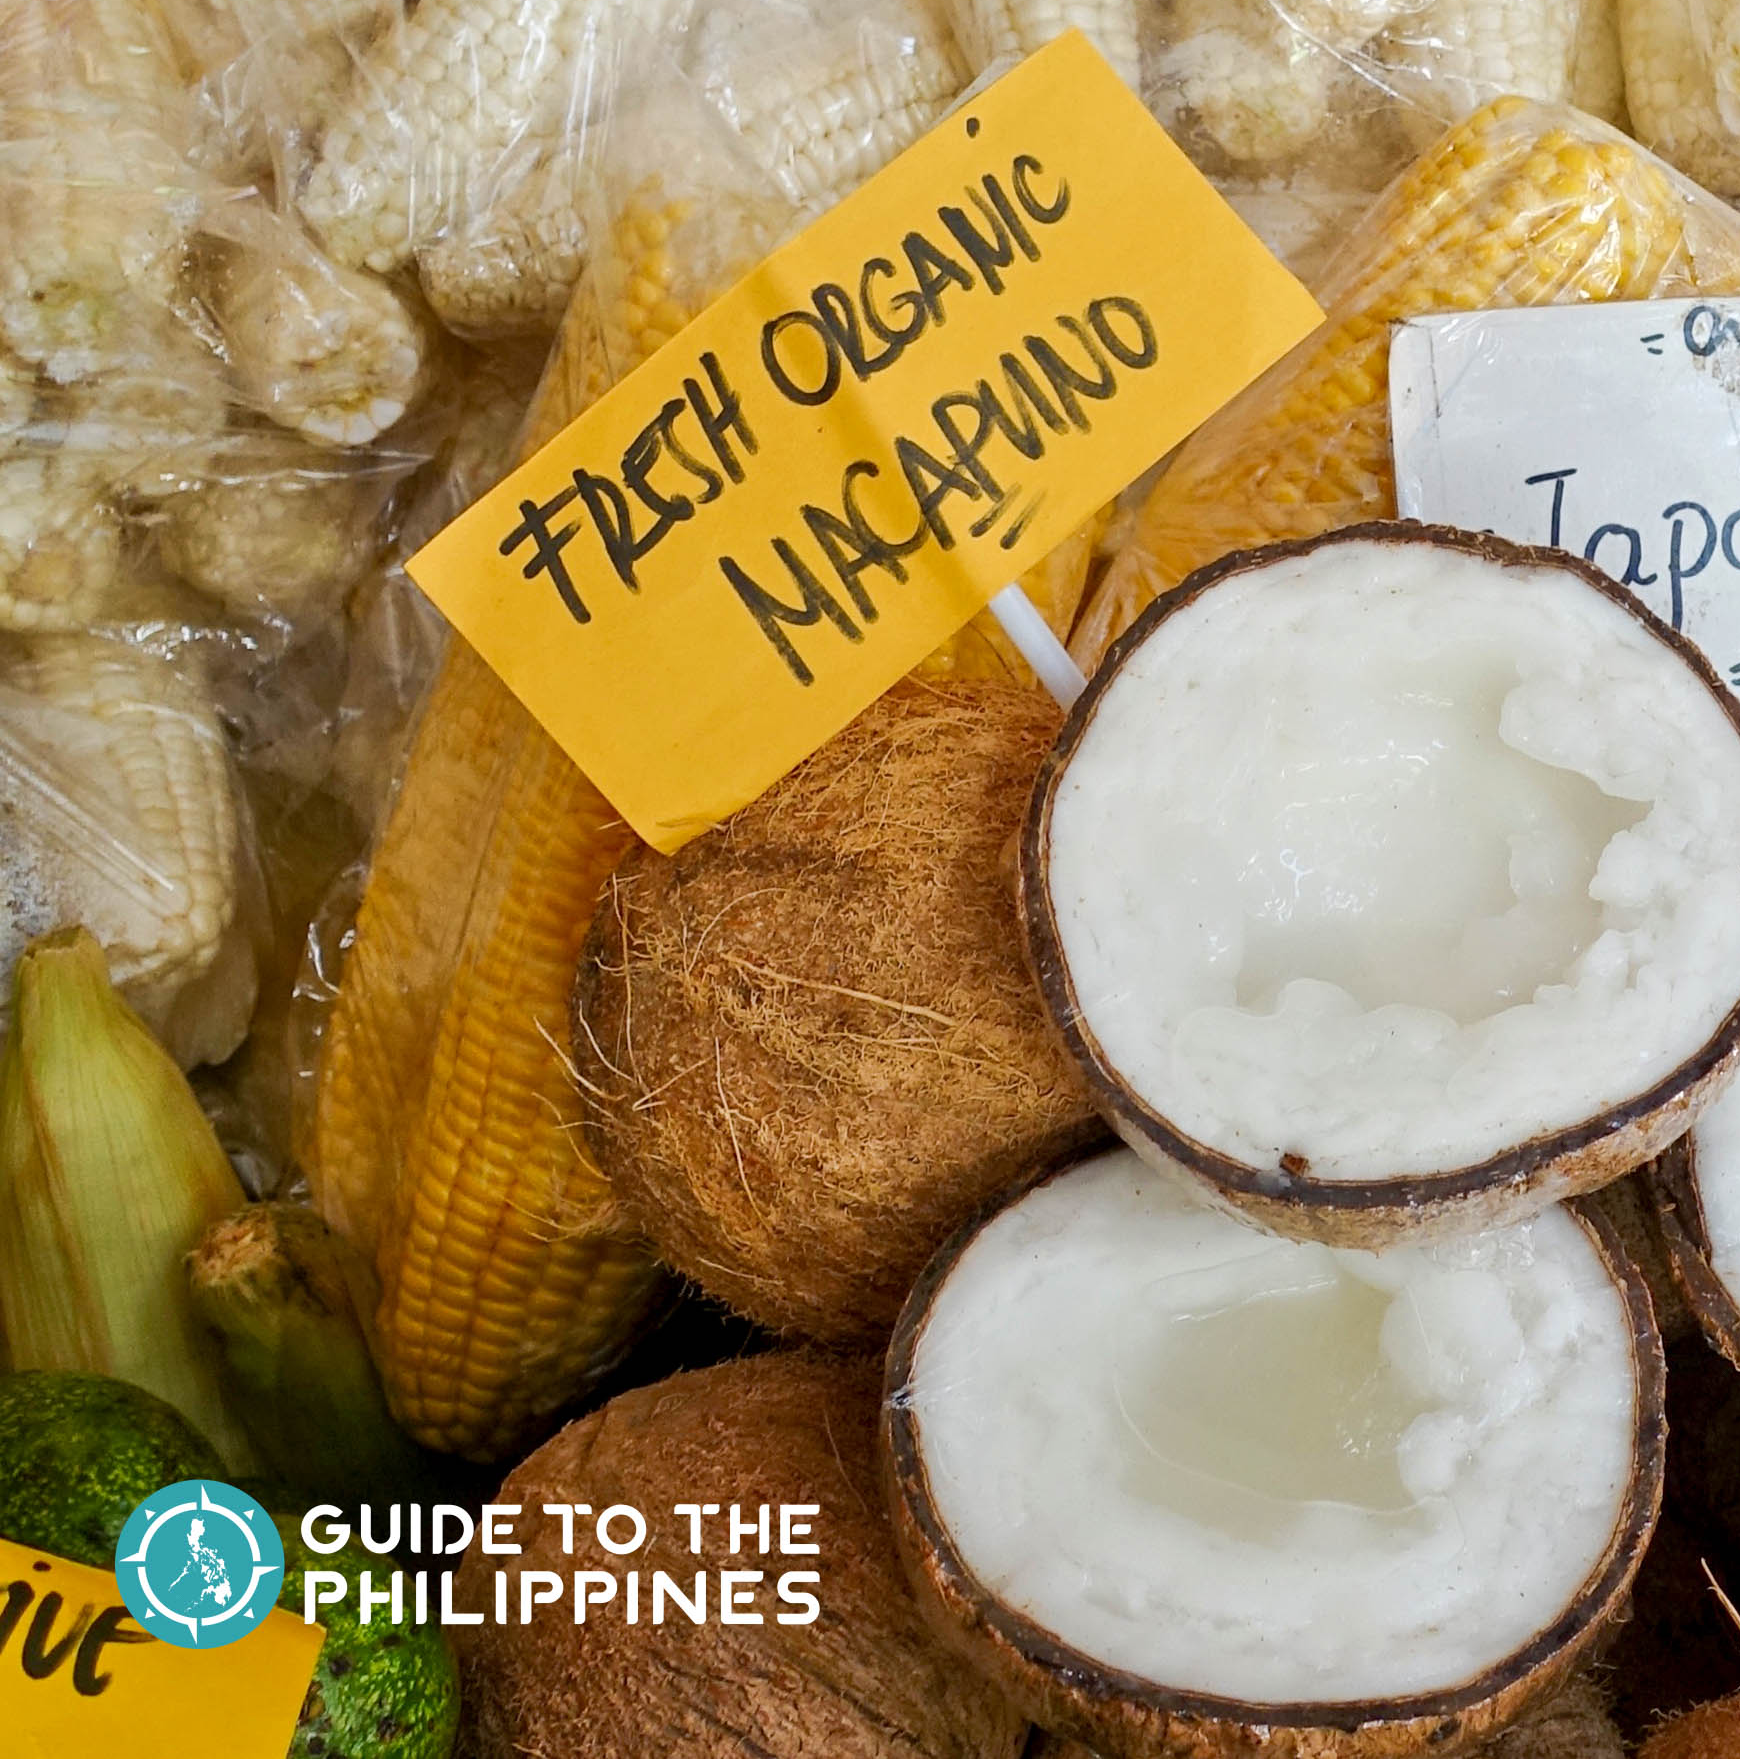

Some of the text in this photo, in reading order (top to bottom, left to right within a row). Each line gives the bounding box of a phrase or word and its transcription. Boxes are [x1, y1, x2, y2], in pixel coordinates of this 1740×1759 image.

[499, 117, 1073, 625] FRESH ORGANIC
[719, 296, 1158, 688] MACAPUNO
